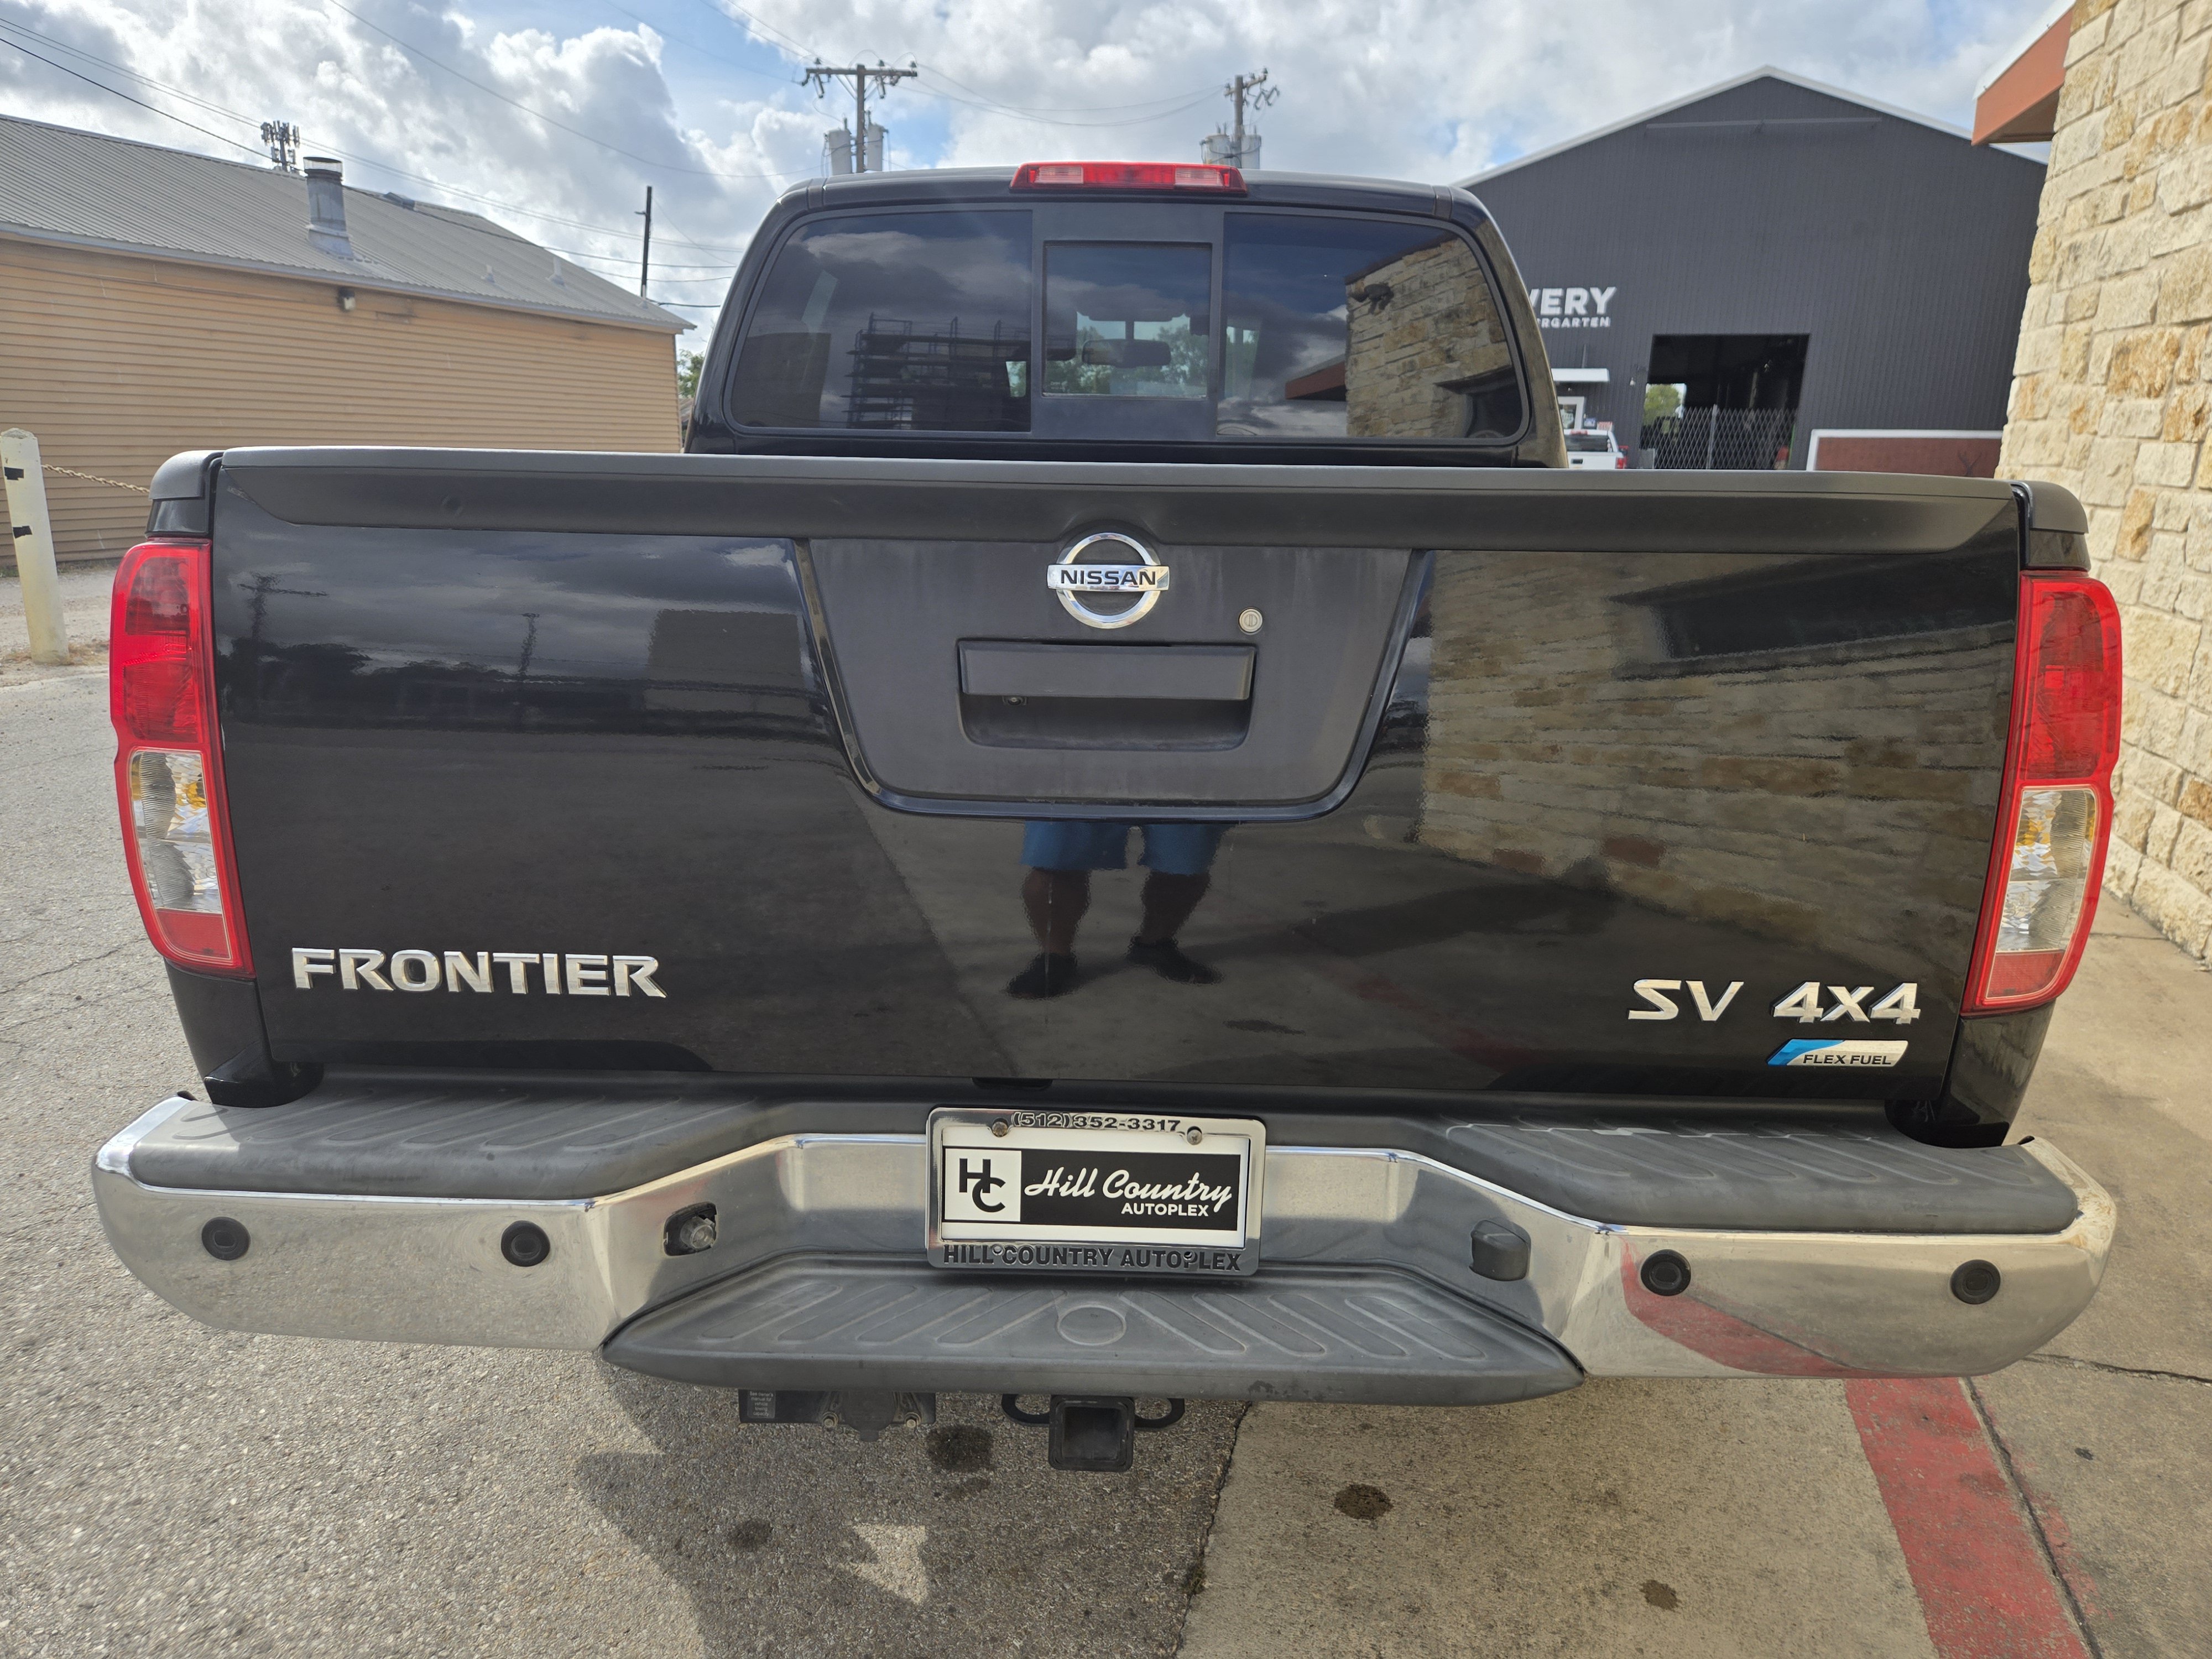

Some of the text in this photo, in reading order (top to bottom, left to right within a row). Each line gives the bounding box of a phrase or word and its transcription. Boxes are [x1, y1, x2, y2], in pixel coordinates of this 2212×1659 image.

[1061, 570, 1156, 585] NISSAN
[292, 948, 666, 998] FRONTIER
[1628, 979, 1744, 1021] SV
[1803, 1053, 1892, 1066] FLEX FUEL
[1024, 1167, 1233, 1213] Hill Country
[1121, 1202, 1209, 1217] AUTOPLEX
[943, 1243, 994, 1265] HILL
[1001, 1245, 1114, 1268] COUNTRY
